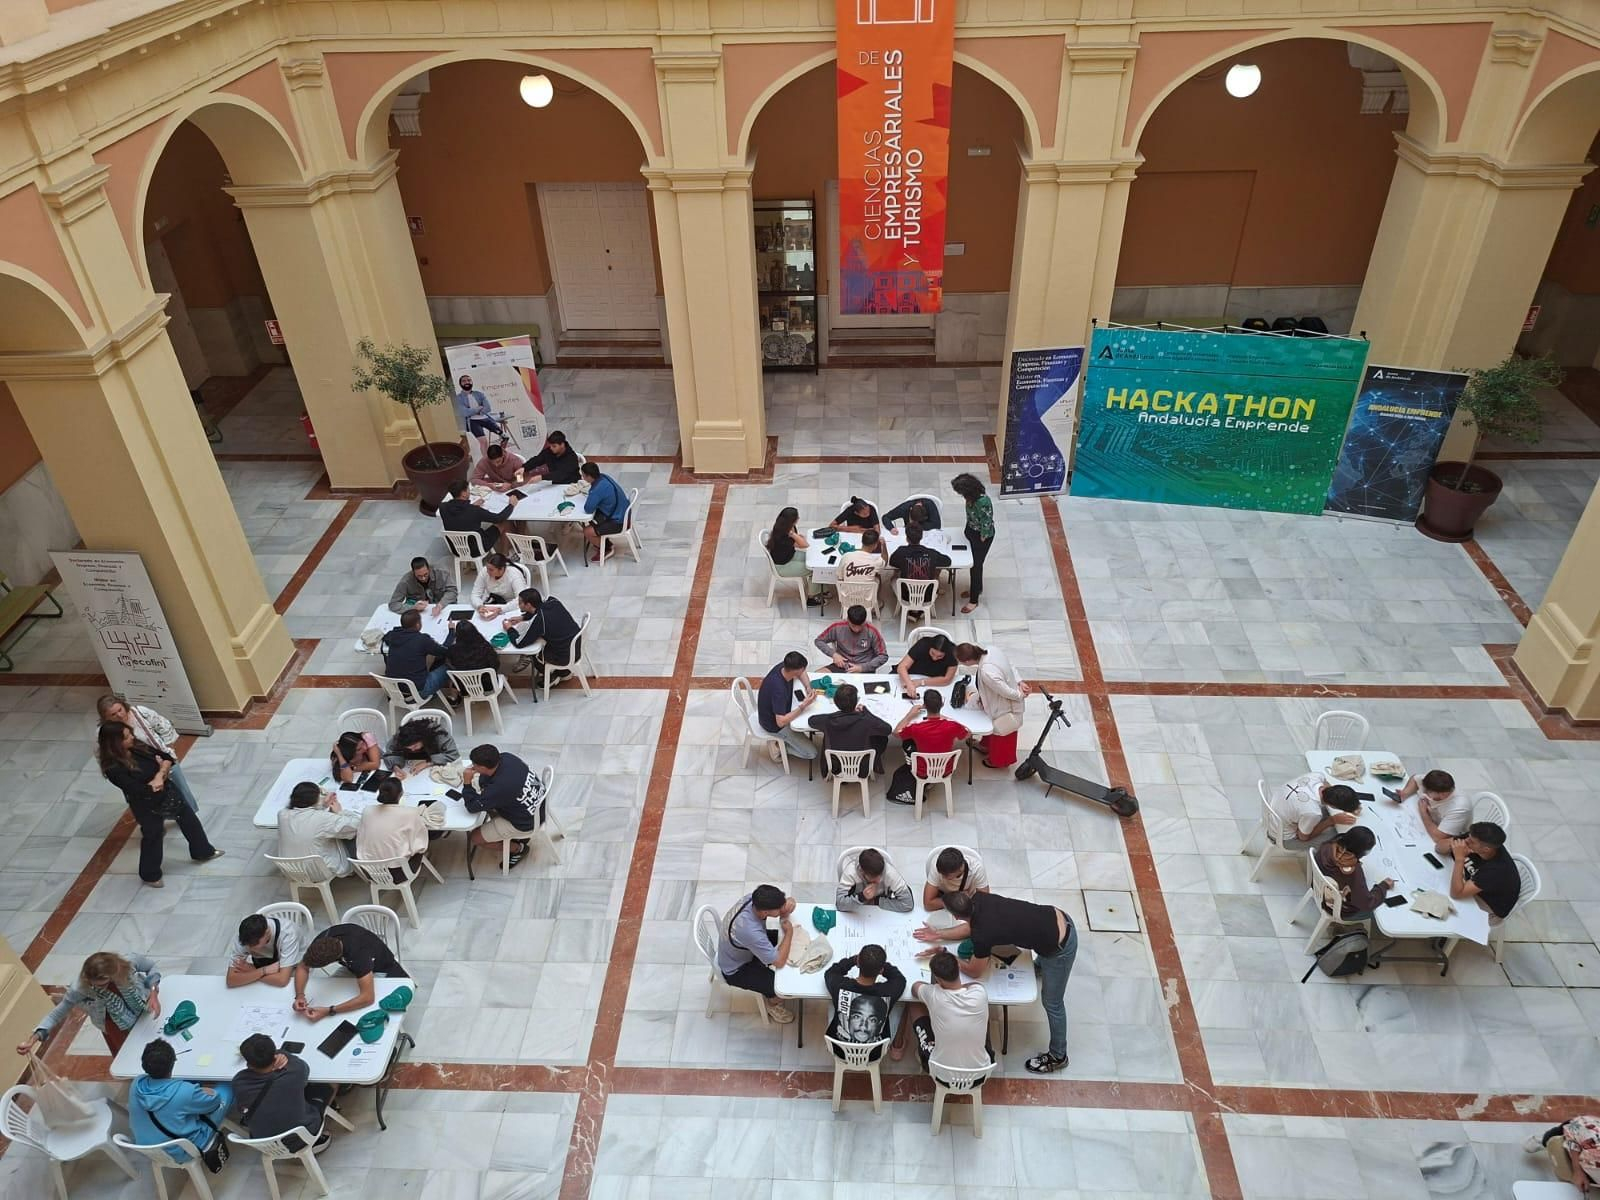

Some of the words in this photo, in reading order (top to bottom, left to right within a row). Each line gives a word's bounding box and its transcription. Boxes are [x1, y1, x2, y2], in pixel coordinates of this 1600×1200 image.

[859, 51, 880, 65] DE
[884, 49, 903, 240] EMPRESARIALES
[864, 129, 882, 240] CIENCIAS
[903, 149, 924, 249] TURISMO
[903, 253, 919, 266] Y
[1106, 387, 1316, 421] HACKATHON
[1138, 411, 1221, 428] Andalucía
[1224, 416, 1310, 433] Emprende
